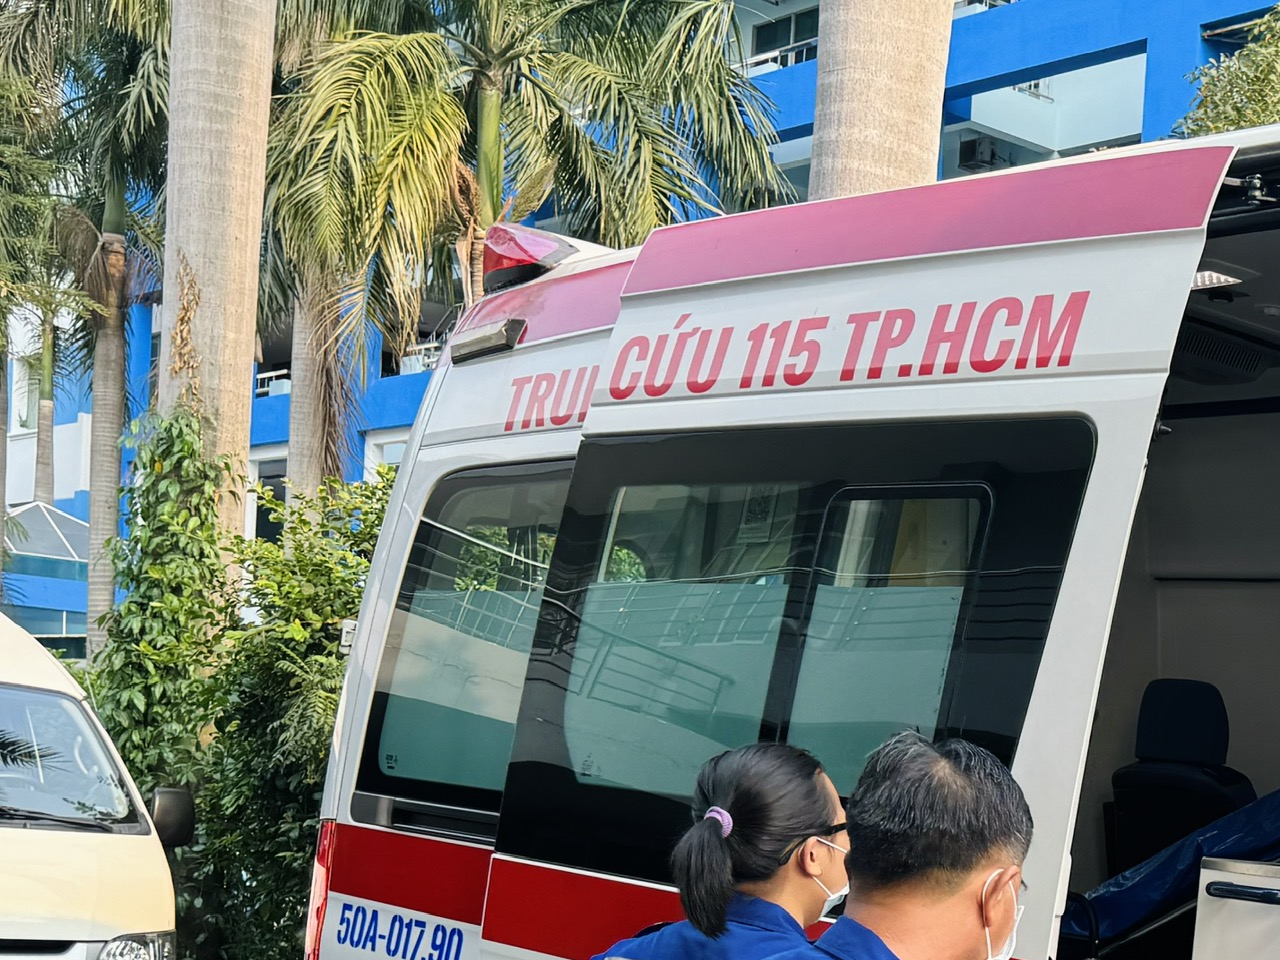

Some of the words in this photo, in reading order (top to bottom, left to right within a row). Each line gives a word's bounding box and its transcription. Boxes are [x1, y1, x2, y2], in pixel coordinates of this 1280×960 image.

[609, 313, 733, 400] CỨU
[738, 316, 830, 390] 115
[839, 290, 1091, 382] TP.HCM
